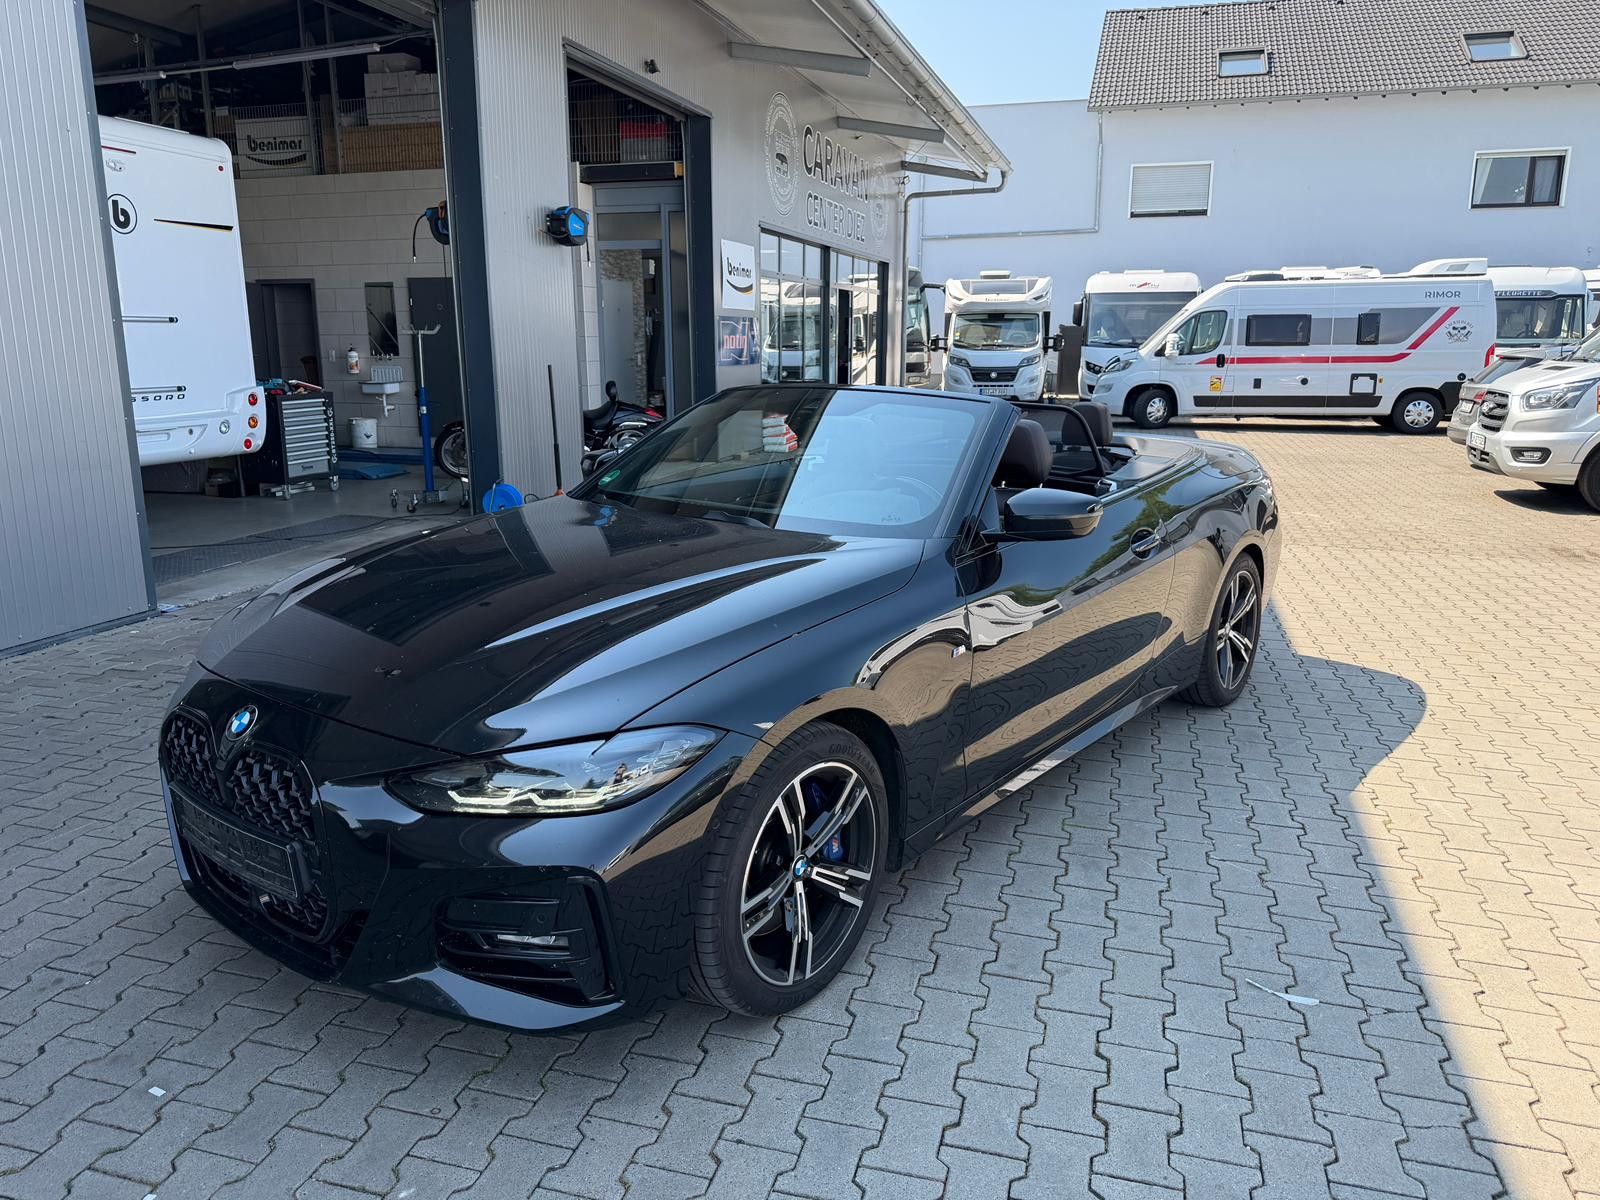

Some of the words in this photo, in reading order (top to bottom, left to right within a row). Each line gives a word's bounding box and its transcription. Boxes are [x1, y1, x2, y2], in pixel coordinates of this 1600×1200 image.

[247, 135, 302, 152] benimar
[803, 125, 870, 203] CARAVAN
[806, 191, 846, 238] CENTER
[847, 207, 866, 242] DIEZ
[727, 257, 752, 279] benimar
[1424, 290, 1461, 298] RIMOR
